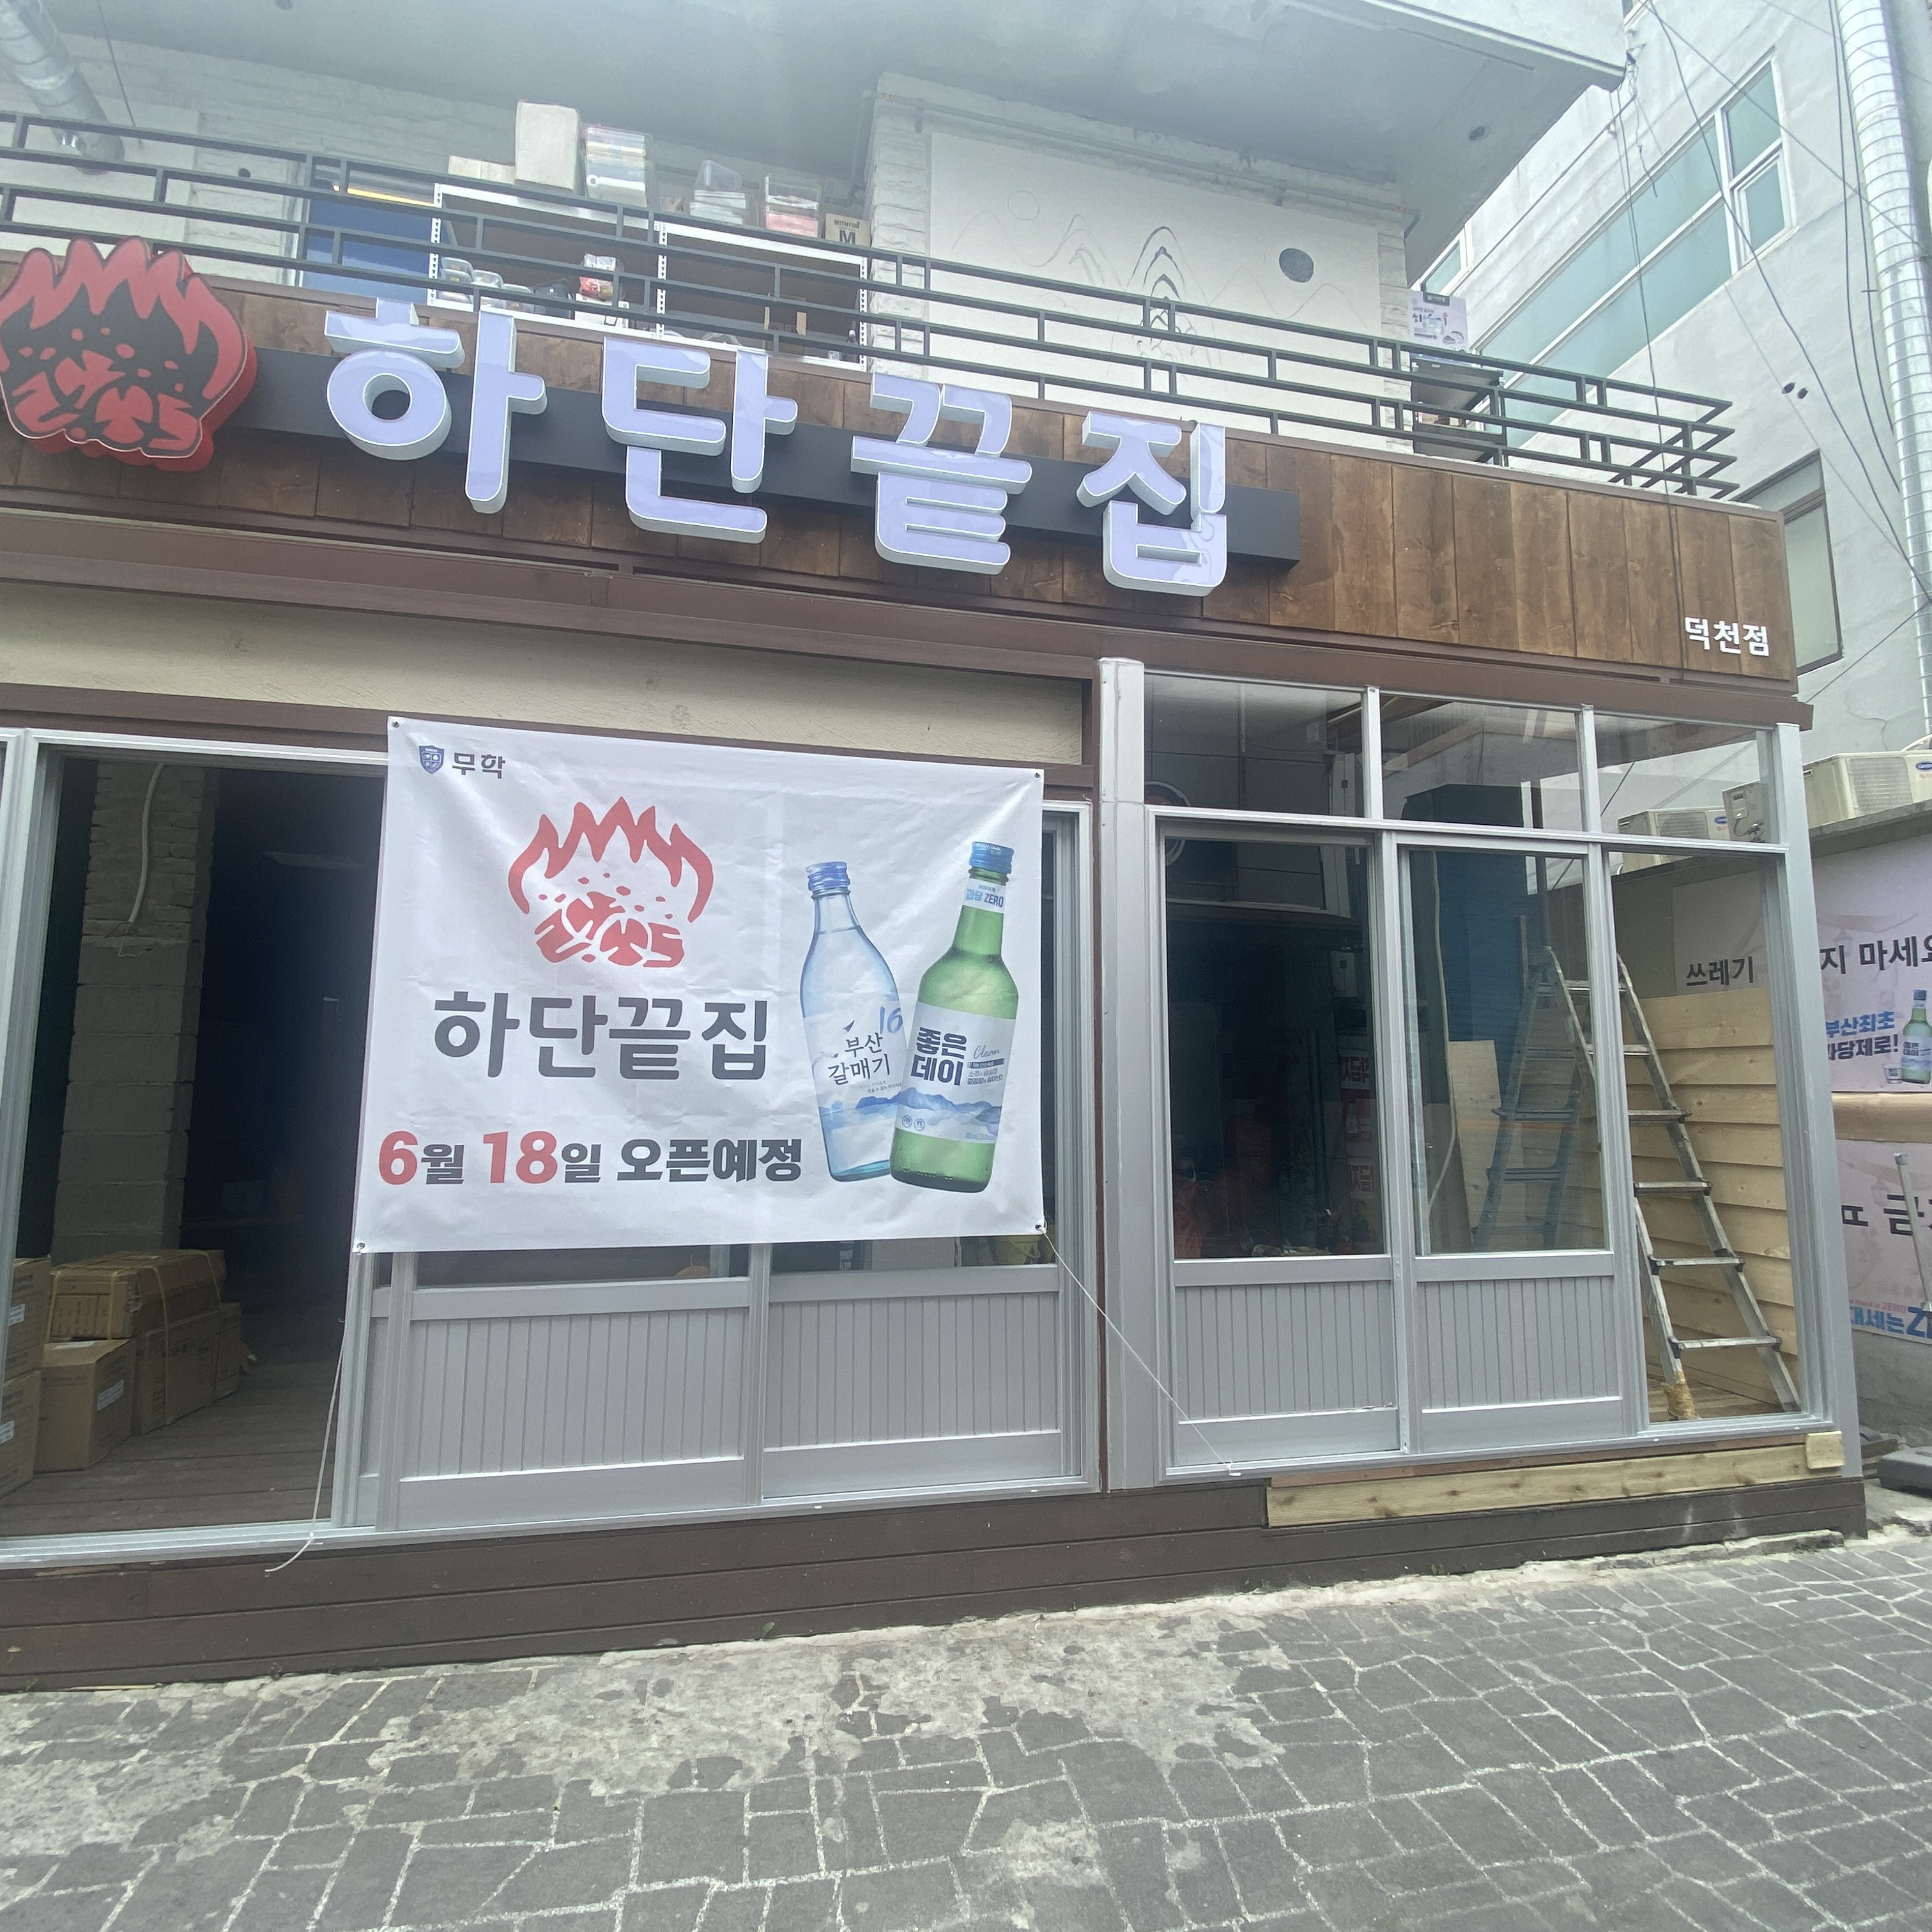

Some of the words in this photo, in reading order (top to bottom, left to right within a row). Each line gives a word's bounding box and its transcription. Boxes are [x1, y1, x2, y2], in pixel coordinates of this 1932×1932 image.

[324, 297, 1227, 596] 하단끝집
[1685, 617, 1769, 657] 덕천점
[452, 752, 506, 779] 무학
[985, 893, 1004, 907] ZERO
[1686, 956, 1754, 986] 쓰레기
[434, 991, 768, 1080] 하단끝집
[880, 1006, 903, 1034] 16
[1826, 1011, 1895, 1038] 부산최초
[845, 1032, 883, 1057] 부산
[916, 1027, 967, 1059] 좋은
[828, 1054, 890, 1085] 갈매기
[910, 1054, 963, 1086] 데이
[379, 1130, 464, 1185] 6월
[483, 1130, 602, 1184] 18일
[617, 1138, 802, 1182] 오픈예정
